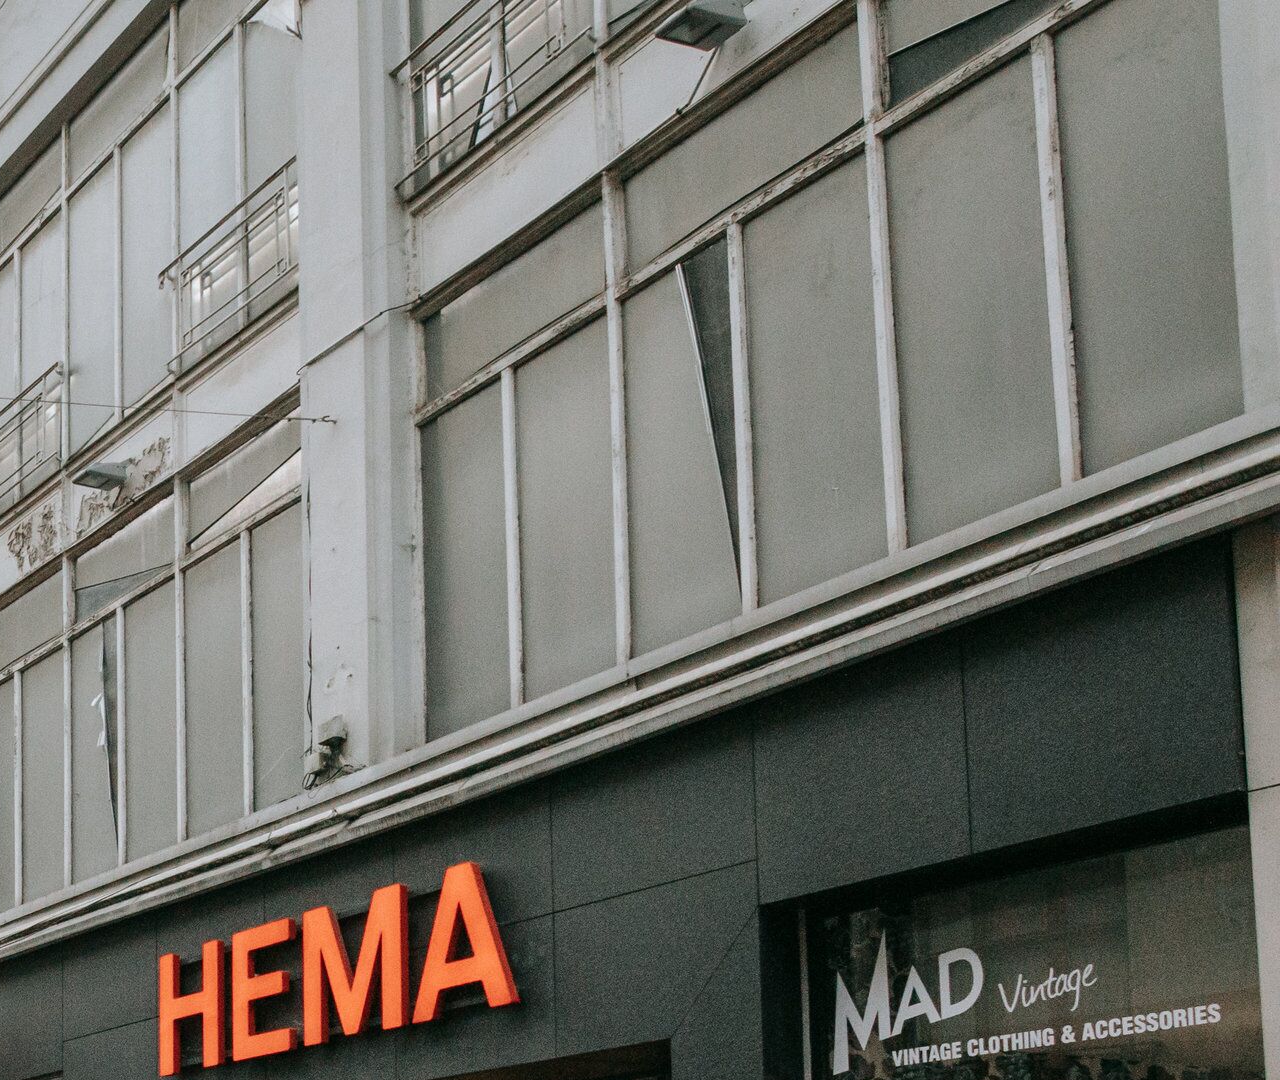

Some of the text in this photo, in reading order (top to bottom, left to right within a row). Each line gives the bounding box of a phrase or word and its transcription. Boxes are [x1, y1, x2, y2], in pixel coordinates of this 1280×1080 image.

[159, 861, 520, 1078] HEMA
[833, 928, 1098, 1076] MAD Vintage
[891, 1003, 1221, 1067] VINTAGE CLOTHING & ACCESSORIES
